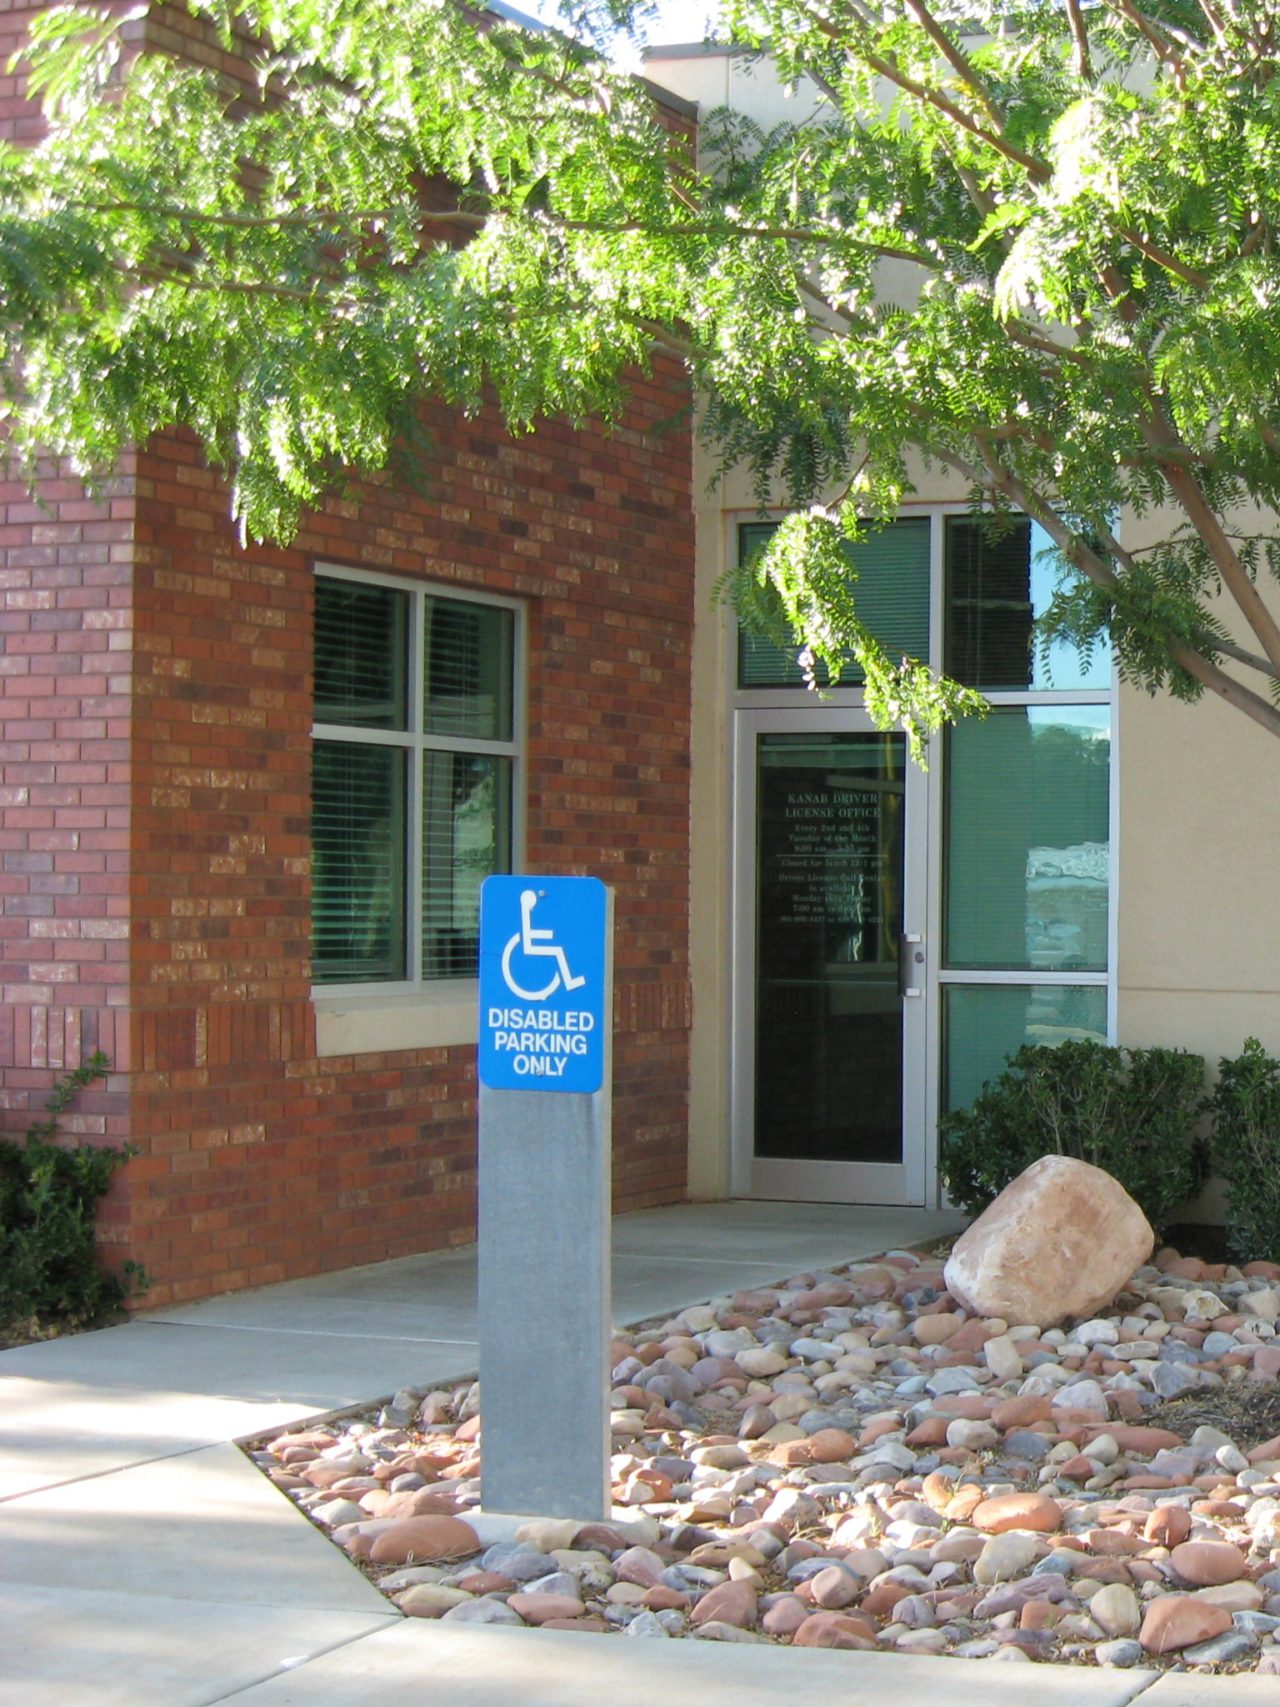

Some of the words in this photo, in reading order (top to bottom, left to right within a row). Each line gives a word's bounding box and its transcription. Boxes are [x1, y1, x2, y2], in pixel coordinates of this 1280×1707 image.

[788, 793, 828, 804] KANAB
[833, 793, 877, 804] DRIVER
[785, 807, 834, 818] LICENSE
[838, 807, 881, 818] OFFICE
[488, 1008, 594, 1031] DISABLED
[495, 1031, 587, 1055] PARKING
[513, 1055, 568, 1076] ONLY
